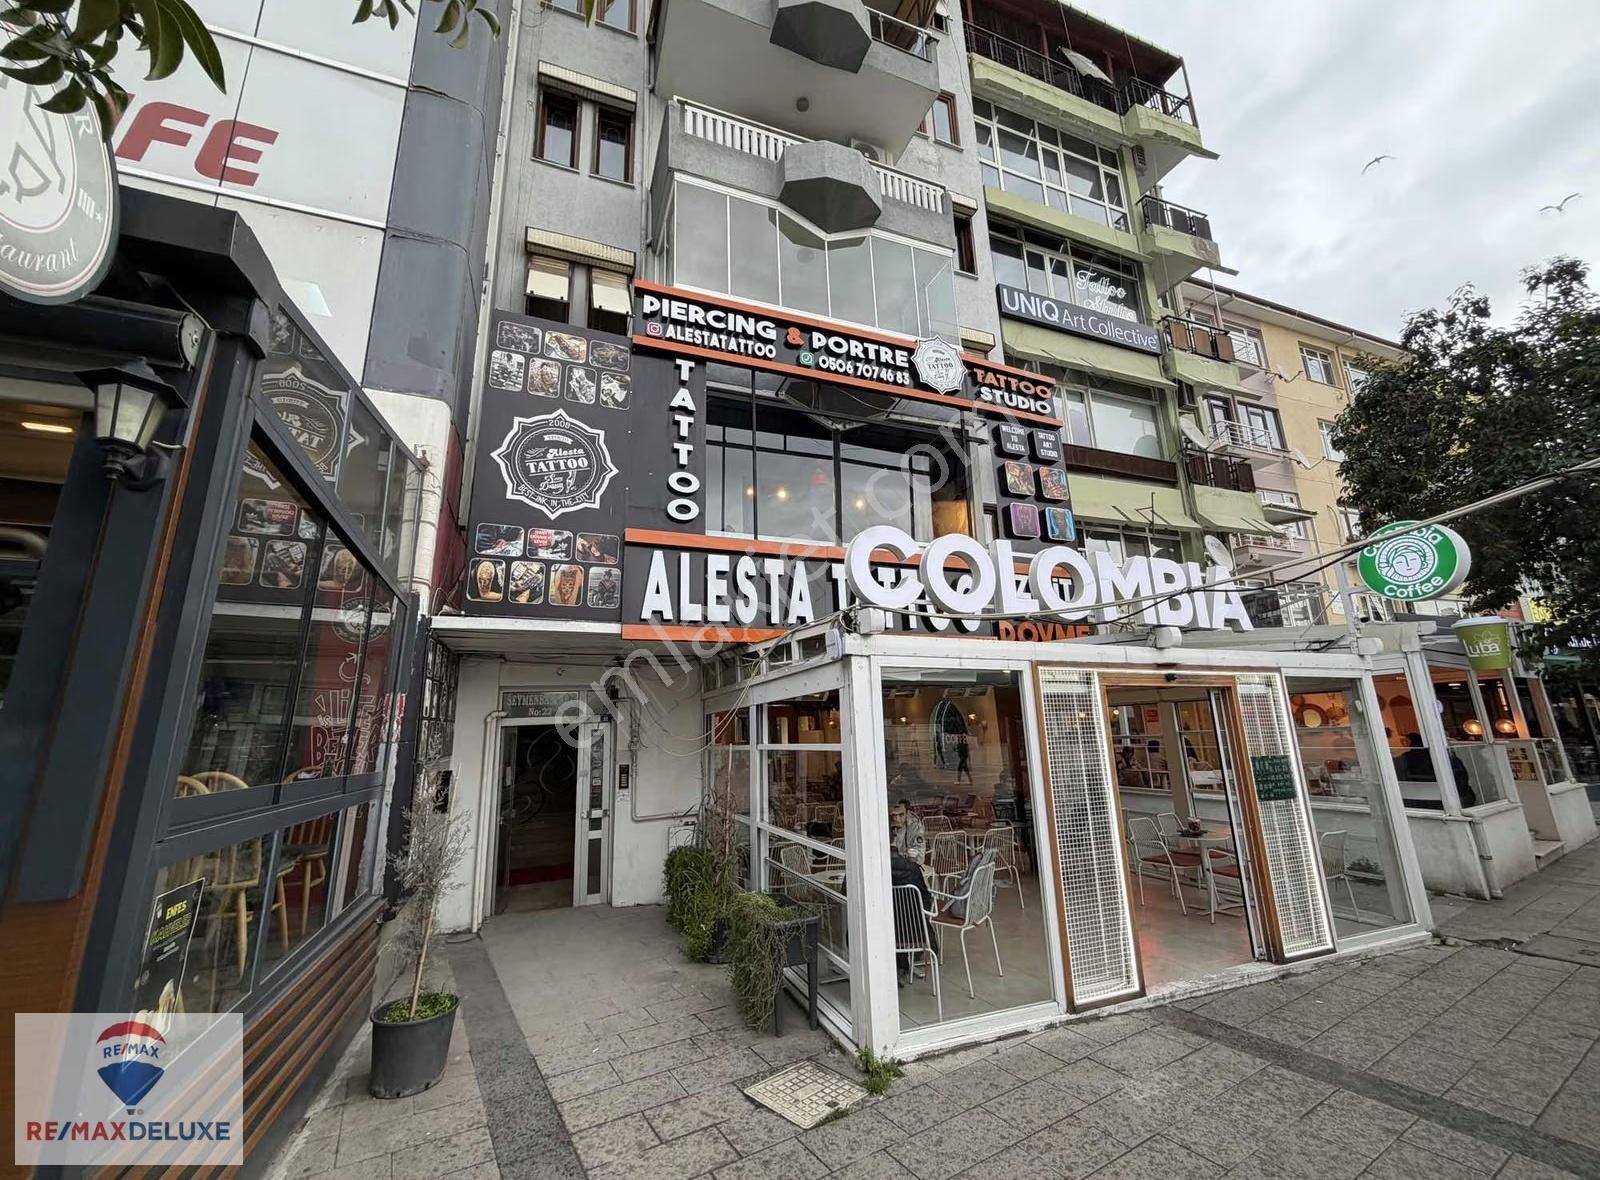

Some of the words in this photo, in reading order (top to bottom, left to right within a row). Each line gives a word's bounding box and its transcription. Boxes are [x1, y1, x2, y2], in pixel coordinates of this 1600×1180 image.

[643, 294, 777, 340] PIERCING
[786, 327, 805, 345] &
[812, 331, 909, 368] PORTRE
[1002, 288, 1059, 323] UNIQ
[1062, 309, 1087, 330] Art
[1088, 316, 1158, 349] Collective
[665, 324, 777, 359] ALESTATATTOO
[818, 355, 853, 374] 0506
[855, 362, 879, 379] 707
[973, 368, 1052, 399] TATTOO
[980, 386, 1052, 414] STUDIO
[667, 358, 700, 521] TATTOO
[1001, 425, 1025, 435] WELCOME
[1037, 432, 1055, 441] TATTOO
[546, 447, 585, 459] Alesta
[1006, 443, 1025, 452] ALESTA
[525, 457, 589, 473] TATTOO
[641, 549, 815, 624] ALESTA
[846, 524, 1255, 631] COLOMBIA
[1383, 576, 1444, 598] Coffee
